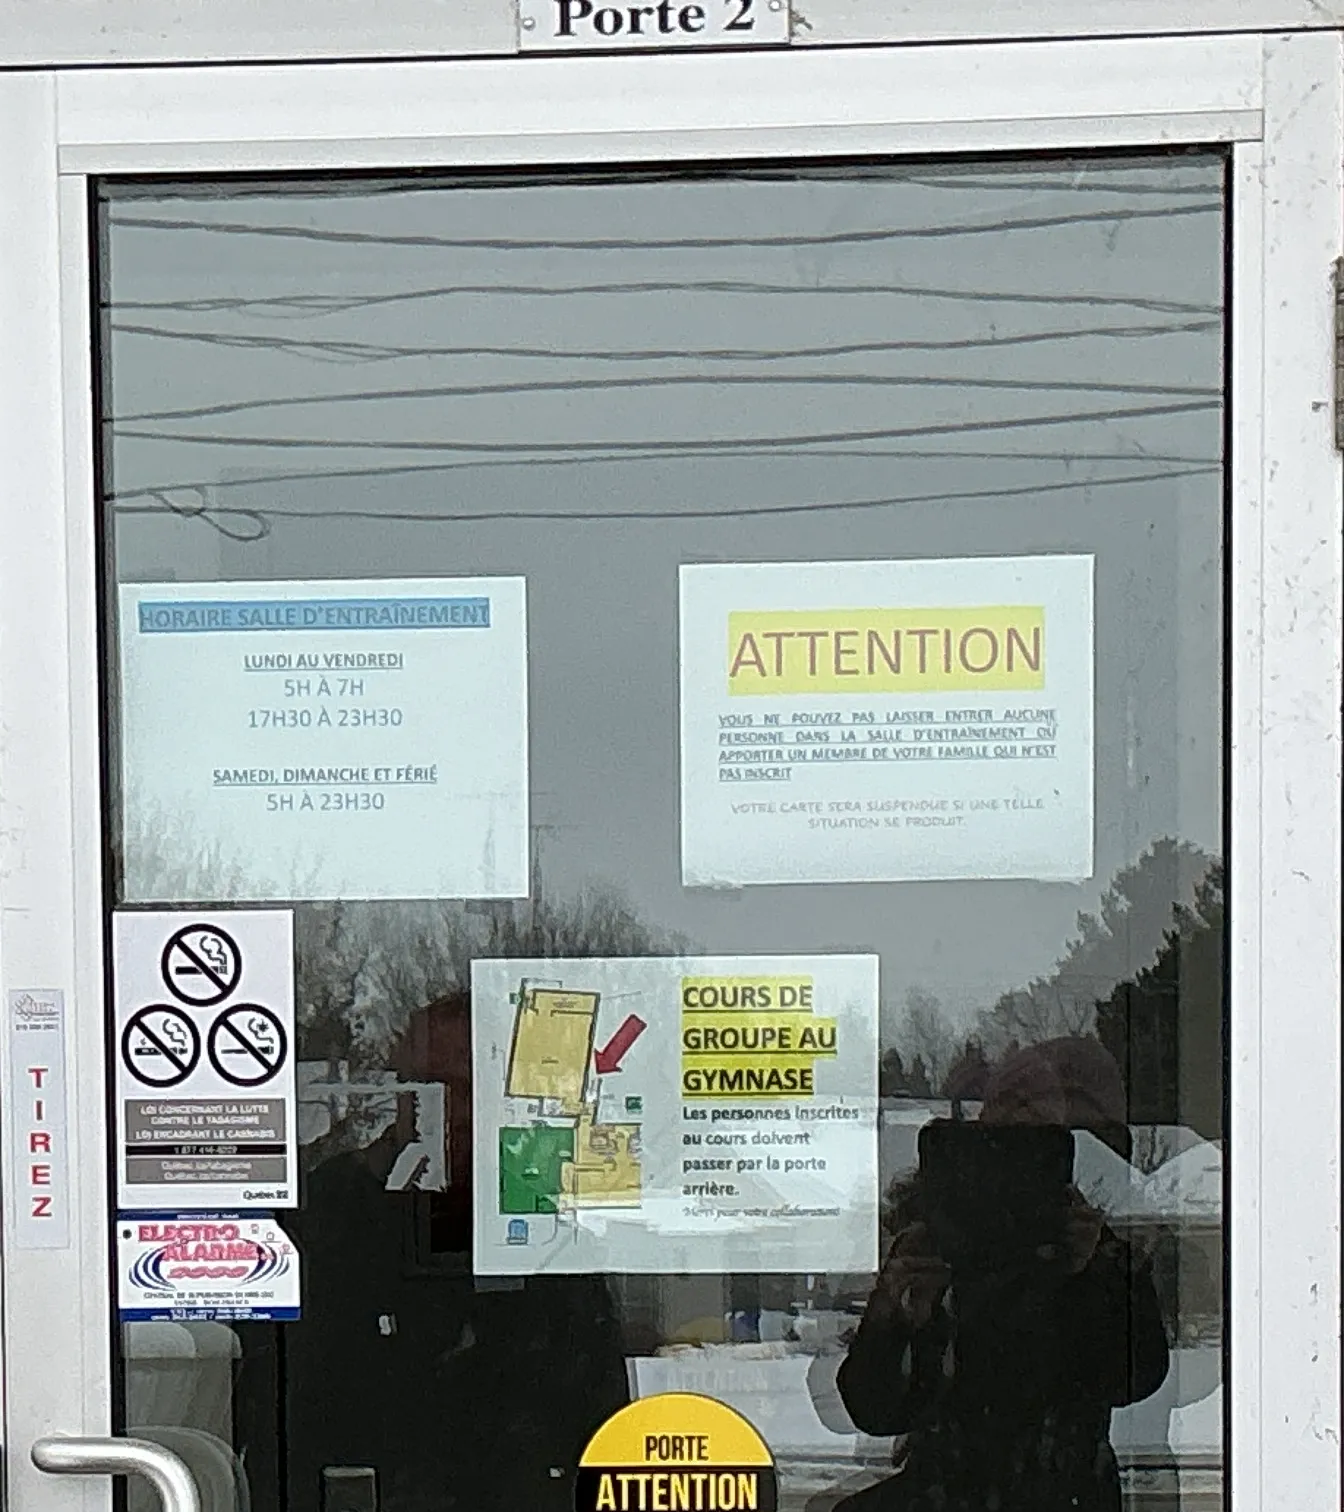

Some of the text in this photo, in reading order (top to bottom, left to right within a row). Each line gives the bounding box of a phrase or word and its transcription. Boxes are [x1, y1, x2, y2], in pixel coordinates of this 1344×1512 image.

[554, 0, 754, 36] Porte 2
[141, 609, 232, 629] HORAIRE
[238, 607, 296, 627] SALLE
[244, 653, 404, 669] LUNDI AU VENDREDI
[729, 628, 1042, 677] ATTENTION
[284, 676, 364, 697] 5H À 7H
[248, 707, 402, 728] 17H30 À 23H30
[719, 714, 753, 726] VOUS
[792, 713, 841, 724] POUVEZ
[852, 712, 875, 723] PAS
[946, 710, 992, 722] ENTRER
[719, 732, 784, 745] PERSONNE
[796, 731, 829, 742] DANS
[841, 731, 855, 742] LA
[719, 750, 783, 763] APPORTER
[788, 750, 807, 761] UN
[812, 749, 866, 759] MEMBRE
[873, 748, 888, 759] DE
[893, 746, 932, 758] VOTRE
[994, 745, 1017, 758] QUI
[213, 765, 437, 785] SAMEDI, DIMANCHE ET FÉRIÉ
[719, 768, 741, 780] PAS
[266, 791, 384, 812] 5H À 23H30
[780, 802, 822, 813] CARTE
[683, 985, 812, 1008] COURS DE
[683, 1027, 836, 1050] GROUPE AU
[683, 1069, 813, 1092] GYMNASE
[683, 1107, 707, 1120] Les
[711, 1107, 790, 1122] personnes
[28, 1067, 52, 1217] TIREZ
[683, 1131, 810, 1145] au cours doivent
[683, 1155, 826, 1174] passer par la porte
[683, 1182, 740, 1197] arrière.
[645, 1436, 709, 1461] PORTE
[596, 1474, 758, 1511] ATTENTION
